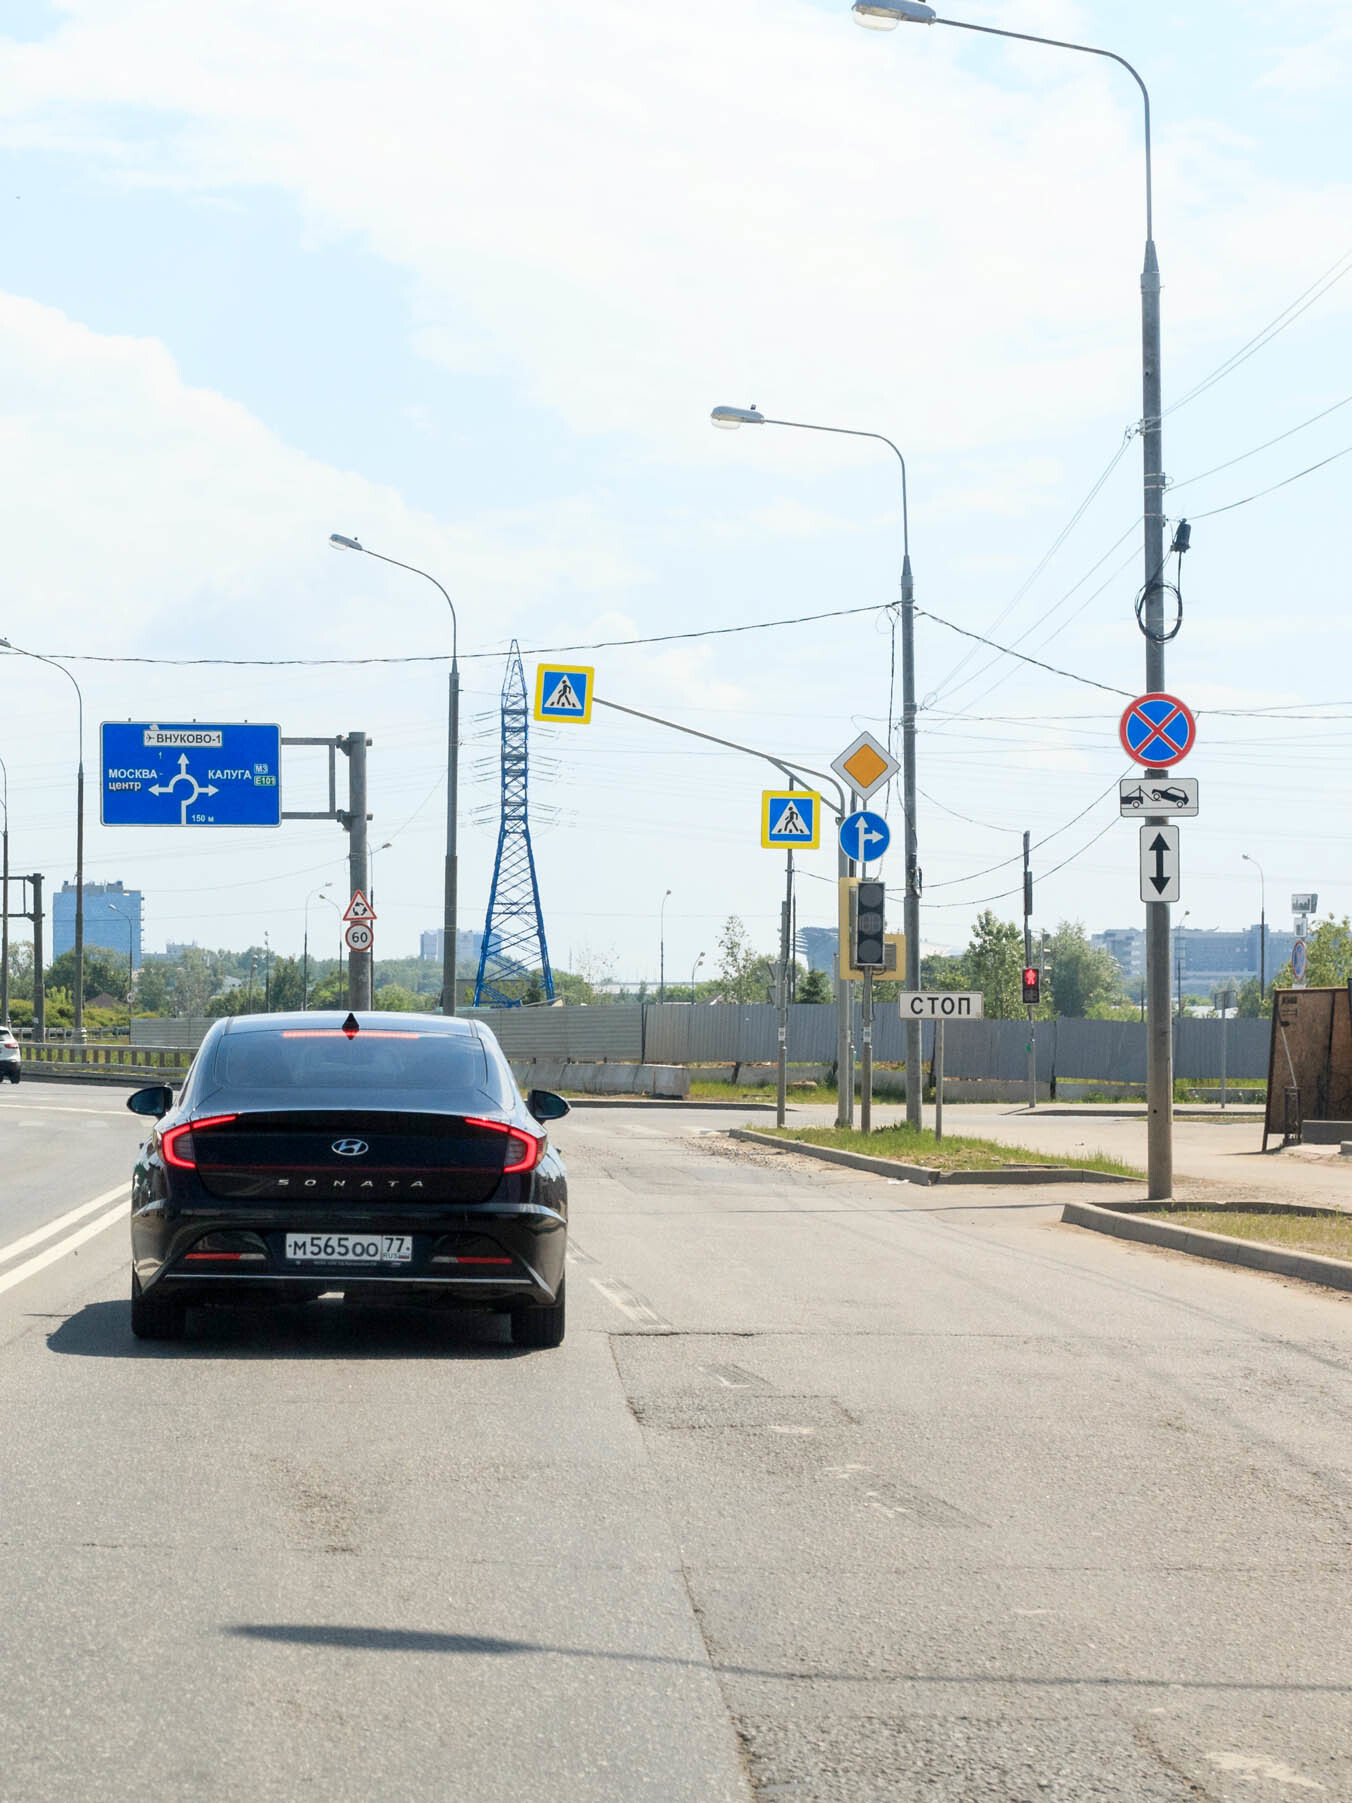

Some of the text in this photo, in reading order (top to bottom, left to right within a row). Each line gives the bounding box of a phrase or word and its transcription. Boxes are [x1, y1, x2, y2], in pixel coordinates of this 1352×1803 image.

[156, 733, 221, 744] ВНУКОВО-1
[255, 764, 268, 773] M3
[108, 769, 158, 779] МОСКВА
[208, 769, 252, 780] КАЛУГА
[255, 776, 276, 786] E101
[108, 782, 142, 792] центр
[191, 814, 206, 822] 150
[351, 932, 368, 943] 60
[910, 996, 971, 1015] СТОП
[277, 1179, 424, 1188] SONATA
[293, 1237, 405, 1257] М565ОО 77
